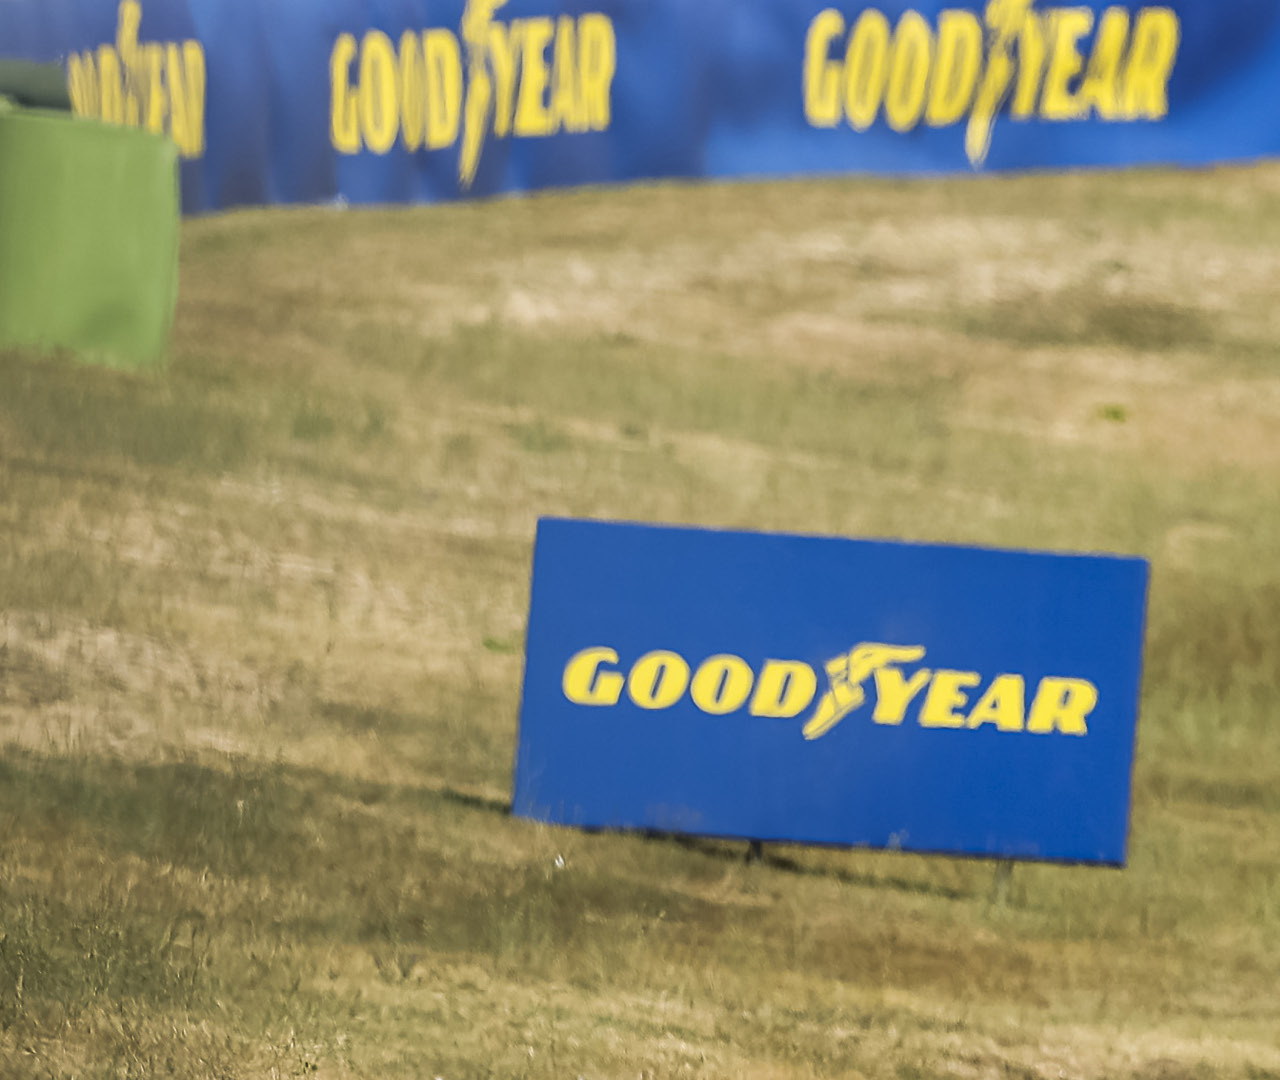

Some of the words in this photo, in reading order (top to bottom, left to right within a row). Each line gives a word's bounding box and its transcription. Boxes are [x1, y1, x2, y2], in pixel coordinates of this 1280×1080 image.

[329, 14, 614, 155] GOODYEAR
[804, 6, 1180, 130] GOODYEAR
[563, 643, 1098, 738] GOODYEAR
